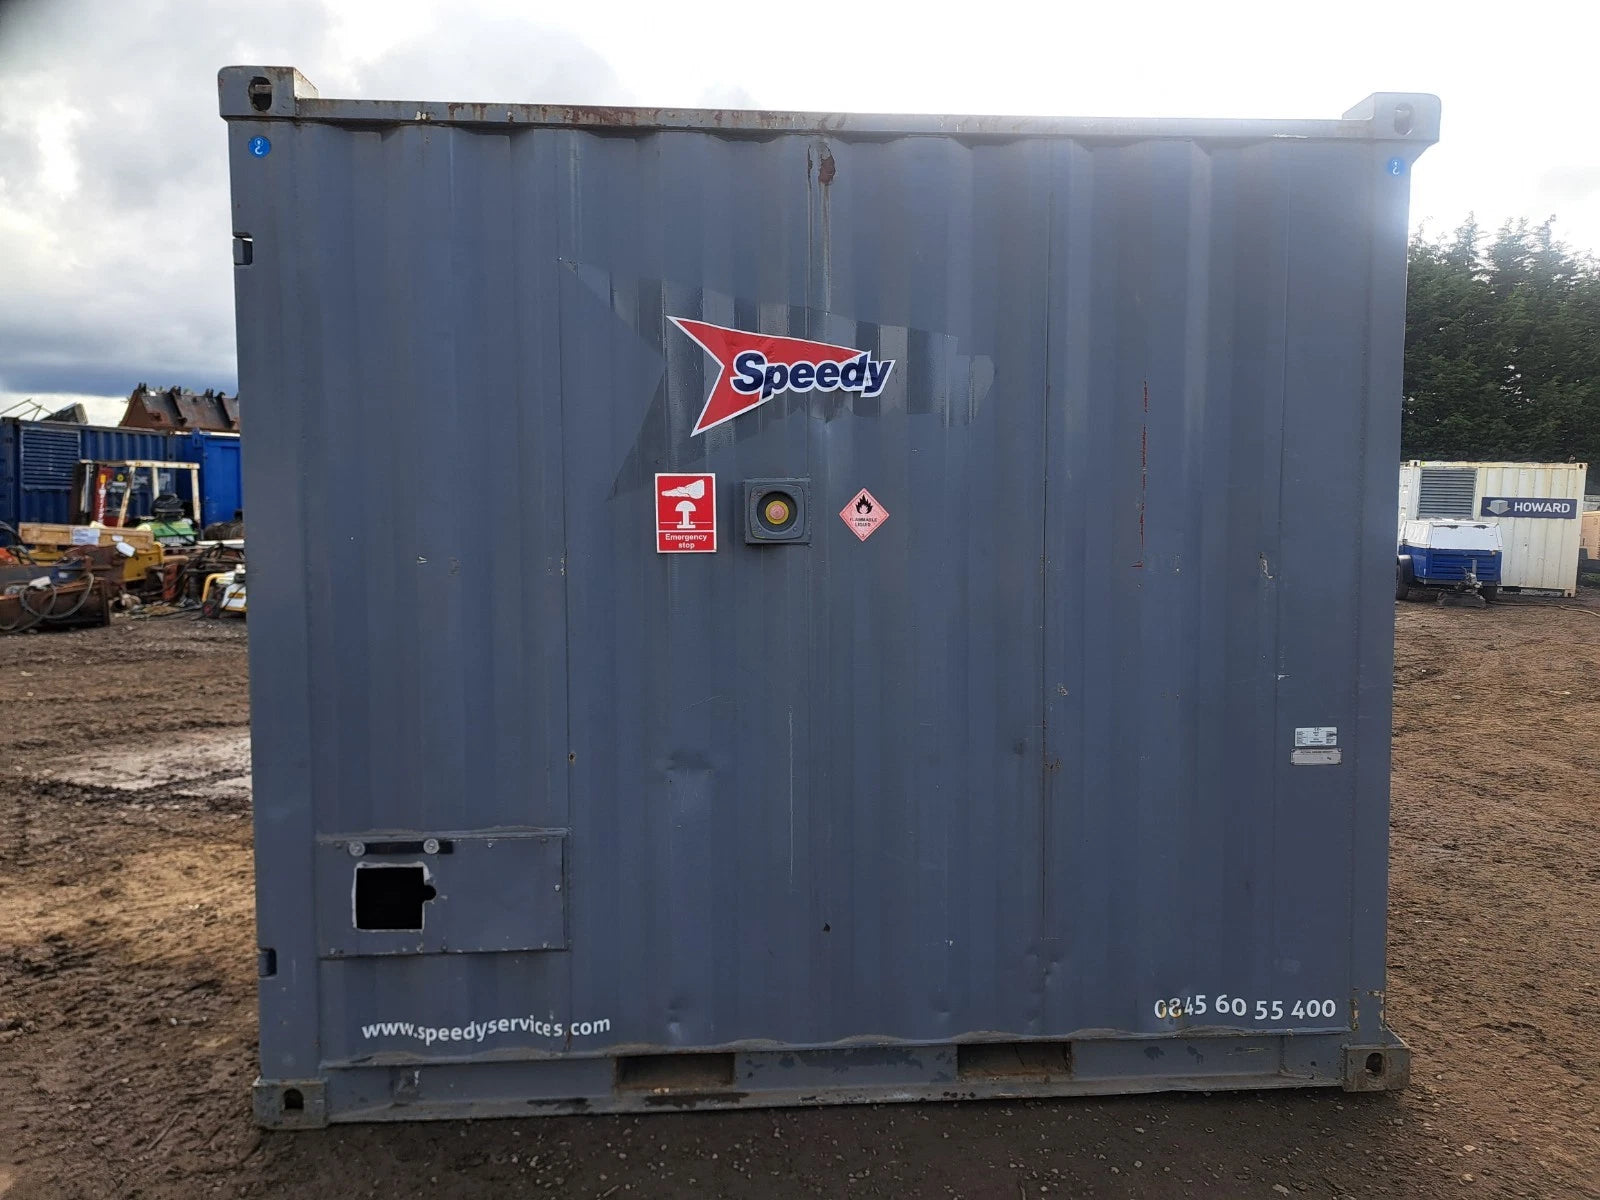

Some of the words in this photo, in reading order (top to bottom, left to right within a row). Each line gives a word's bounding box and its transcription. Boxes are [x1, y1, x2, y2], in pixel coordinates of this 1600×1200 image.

[733, 351, 891, 399] Speedy
[1514, 501, 1571, 513] HOWARD
[665, 533, 708, 542] Emergency
[678, 541, 695, 549] stop
[1154, 994, 1207, 1019] 0845
[1215, 994, 1247, 1017] 60
[1254, 1000, 1284, 1021] 55
[1291, 999, 1337, 1020] 400
[361, 1014, 611, 1046] www.speedyservices.com
